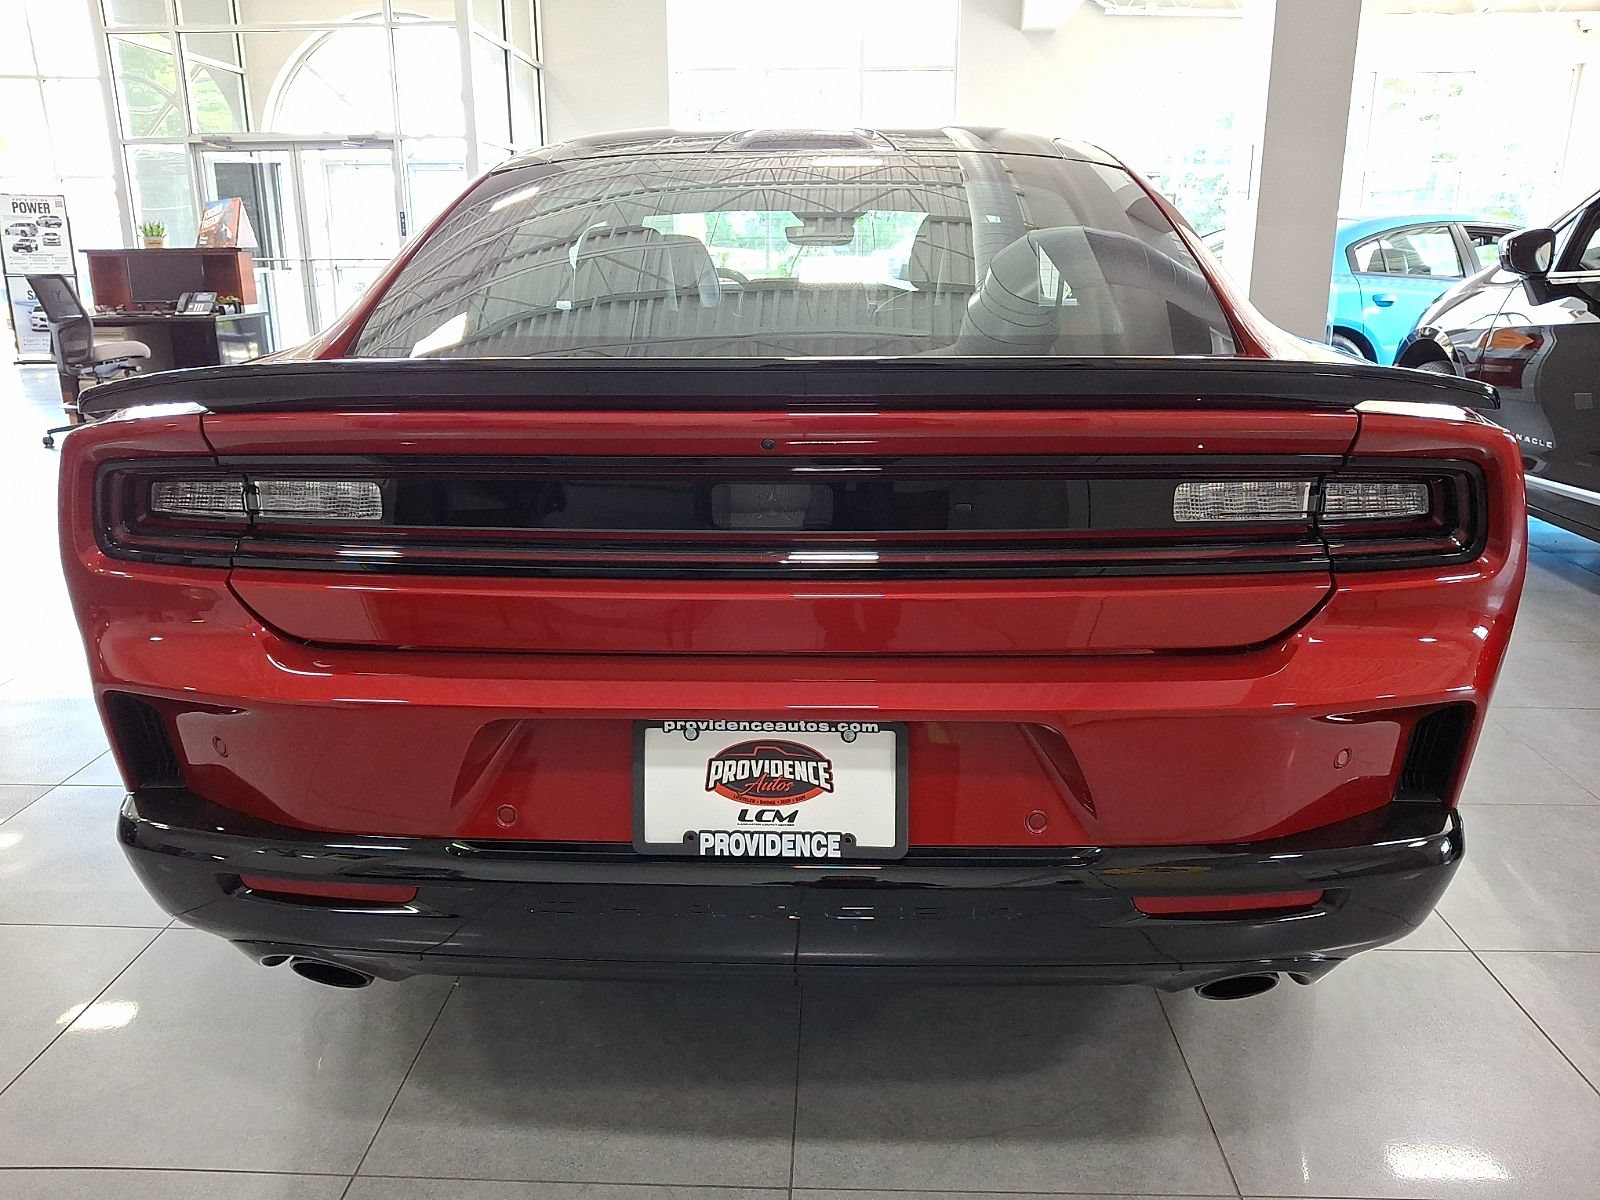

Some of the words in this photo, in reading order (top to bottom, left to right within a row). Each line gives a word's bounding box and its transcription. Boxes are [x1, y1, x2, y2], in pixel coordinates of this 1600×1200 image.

[12, 202, 51, 214] POWER
[1515, 433, 1553, 449] NACLE
[663, 719, 879, 733] providenceautos.com
[708, 759, 832, 790] PROVIDENCE
[738, 772, 795, 796] Autos
[737, 808, 799, 823] LCM
[699, 832, 841, 857] PROVIDENCE
